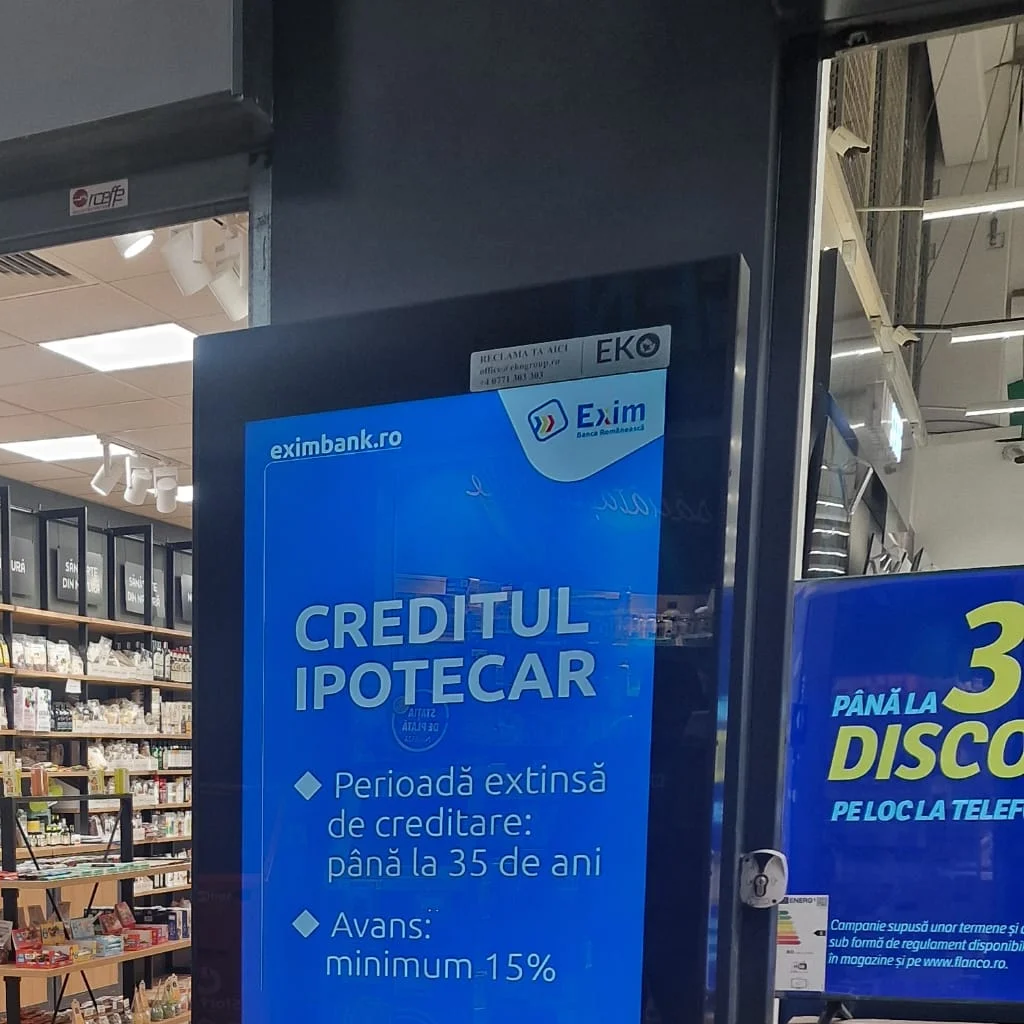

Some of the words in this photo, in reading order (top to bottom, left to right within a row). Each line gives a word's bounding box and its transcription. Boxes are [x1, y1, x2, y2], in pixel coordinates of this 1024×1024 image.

[479, 350, 528, 364] RECLAMA
[531, 346, 544, 357] TA
[547, 343, 568, 355] AICI
[596, 332, 661, 364] EKO
[577, 400, 645, 428] Exim
[270, 428, 402, 460] eximbank.ro
[576, 431, 598, 439] Banca
[295, 587, 589, 651] CREDITUL
[296, 650, 596, 711] IPOTECAR
[832, 688, 901, 717] PÂNĂ
[904, 691, 937, 715] LA
[335, 765, 473, 799] Perioadă
[484, 761, 607, 795] extinsă
[328, 808, 365, 838] de
[376, 806, 531, 838] creditare:
[830, 801, 864, 822] PE
[864, 800, 913, 821] LOC
[915, 800, 945, 821] LA
[951, 799, 1024, 821] TELEF
[328, 847, 401, 883] până
[413, 847, 437, 878] la
[448, 848, 488, 878] 35
[499, 845, 540, 877] de
[551, 846, 602, 877] ani
[330, 911, 432, 940] Avans:
[830, 919, 886, 934] Campanie
[888, 920, 929, 935] supusă
[930, 923, 956, 934] unor
[959, 922, 1006, 935] termene
[1008, 923, 1019, 937] și
[828, 936, 848, 949] sub
[850, 937, 884, 950] formă
[885, 937, 900, 949] de
[901, 938, 966, 952] regulament
[326, 949, 473, 979] minimum
[486, 952, 556, 982] 15%
[827, 952, 839, 965] în
[840, 955, 894, 969] magazine
[895, 955, 905, 969] și
[907, 957, 922, 969] pe
[923, 957, 1009, 970] www.flanco.ro.
